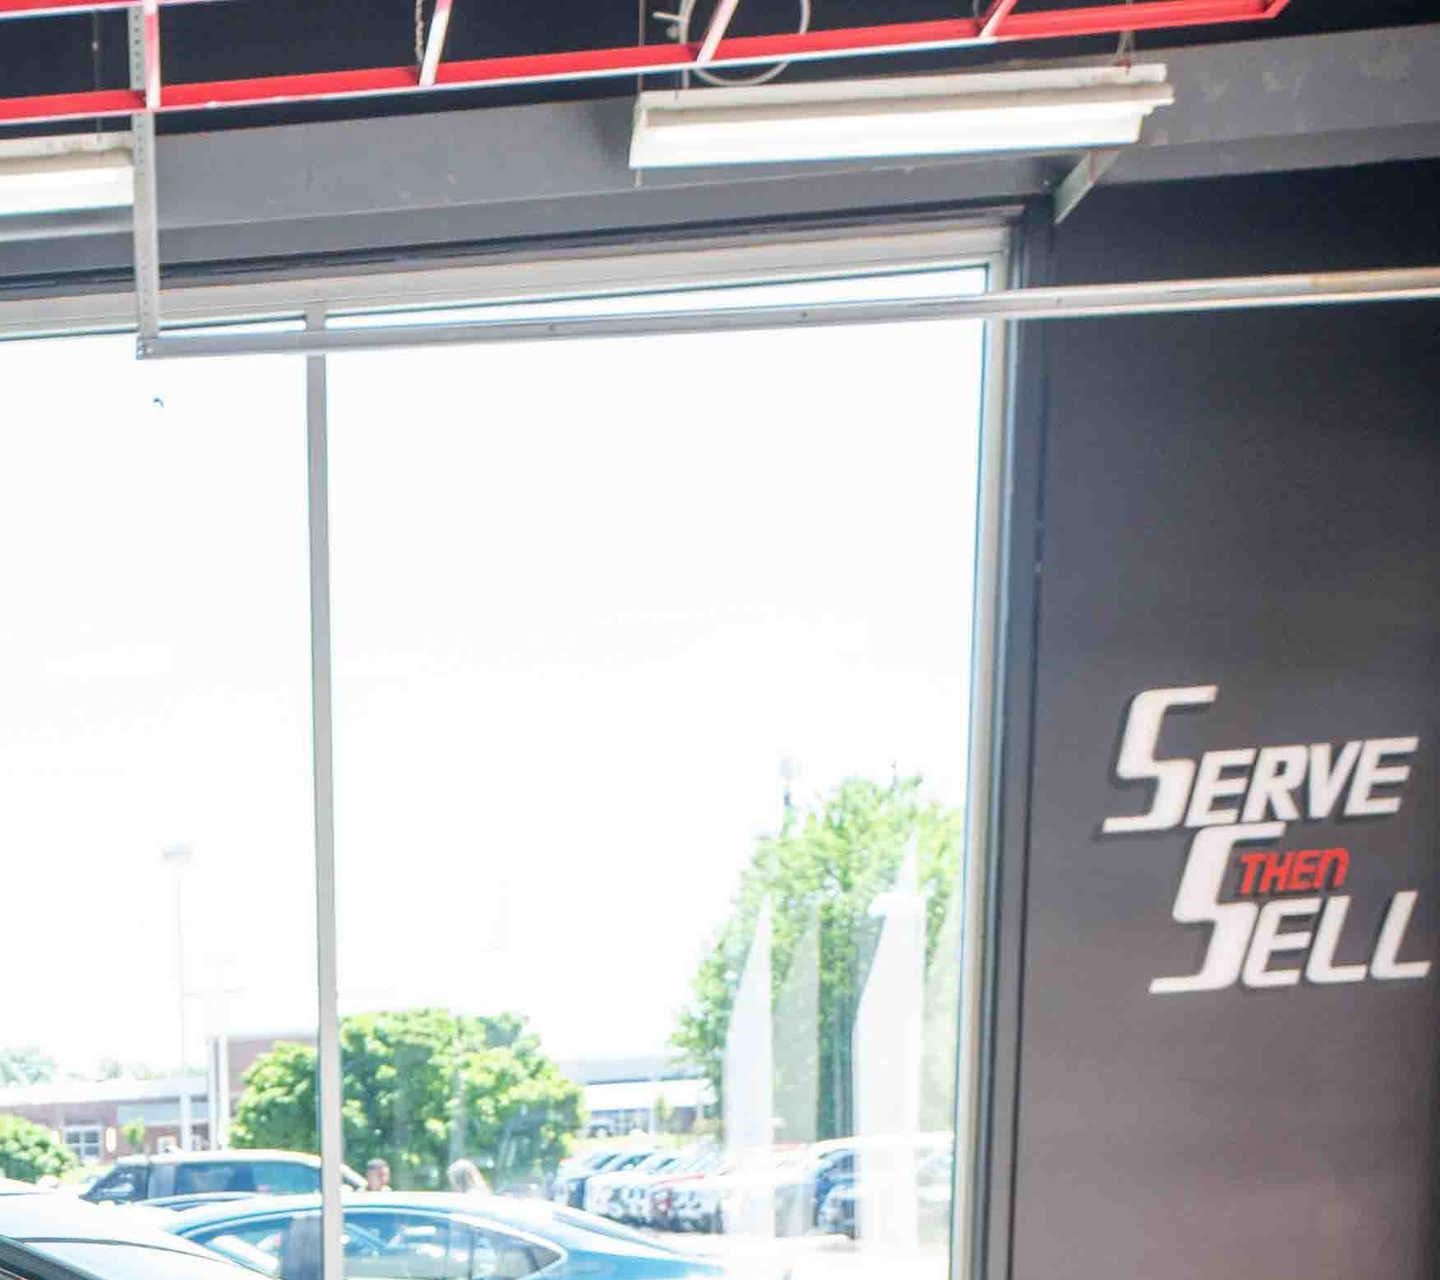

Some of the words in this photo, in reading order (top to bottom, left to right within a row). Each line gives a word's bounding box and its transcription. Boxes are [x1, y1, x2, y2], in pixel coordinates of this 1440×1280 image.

[1103, 686, 1419, 832] SERVE
[1150, 822, 1431, 993] SELL
[1239, 847, 1350, 895] THEN
